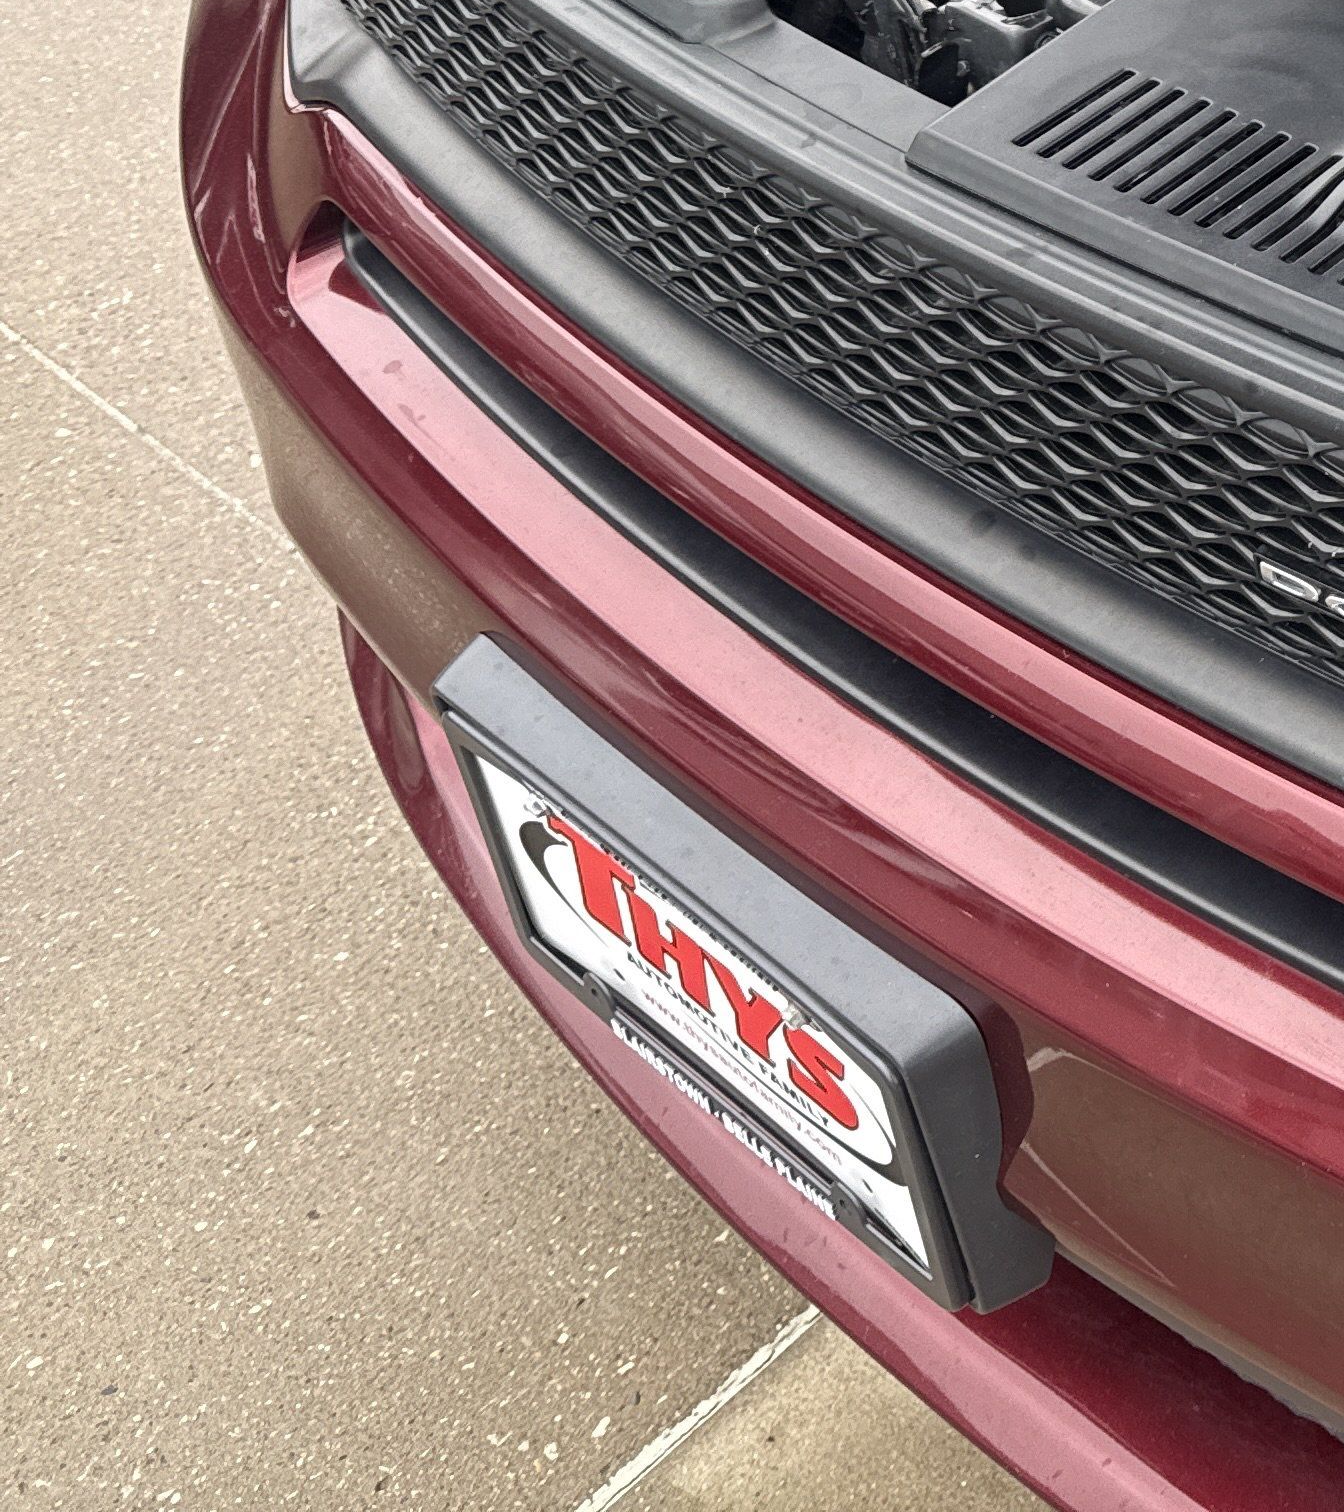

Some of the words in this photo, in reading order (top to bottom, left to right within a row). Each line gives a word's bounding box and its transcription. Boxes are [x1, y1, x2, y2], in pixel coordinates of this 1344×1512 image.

[546, 813, 859, 1131] THYS
[627, 951, 755, 1065] AUTOMOTIVE
[758, 1060, 829, 1127] FAMILY
